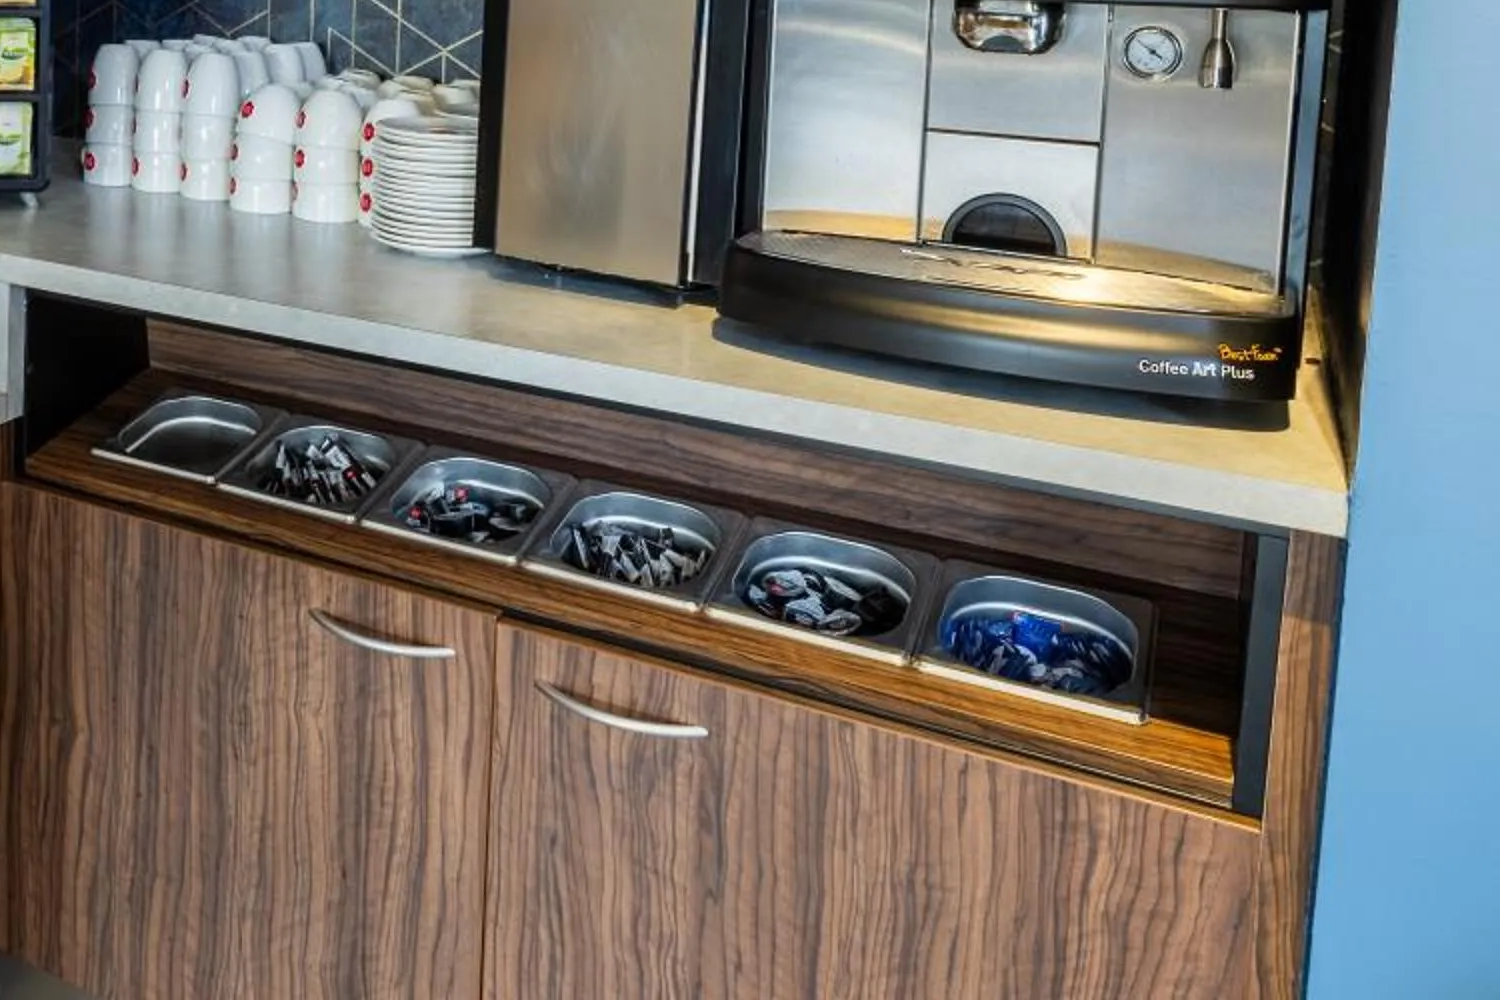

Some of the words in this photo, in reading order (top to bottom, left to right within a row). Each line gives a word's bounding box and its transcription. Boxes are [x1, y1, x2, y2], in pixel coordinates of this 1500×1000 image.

[1139, 360, 1189, 375] Coffee
[1192, 361, 1216, 377] Art
[1221, 366, 1255, 380] Plus
